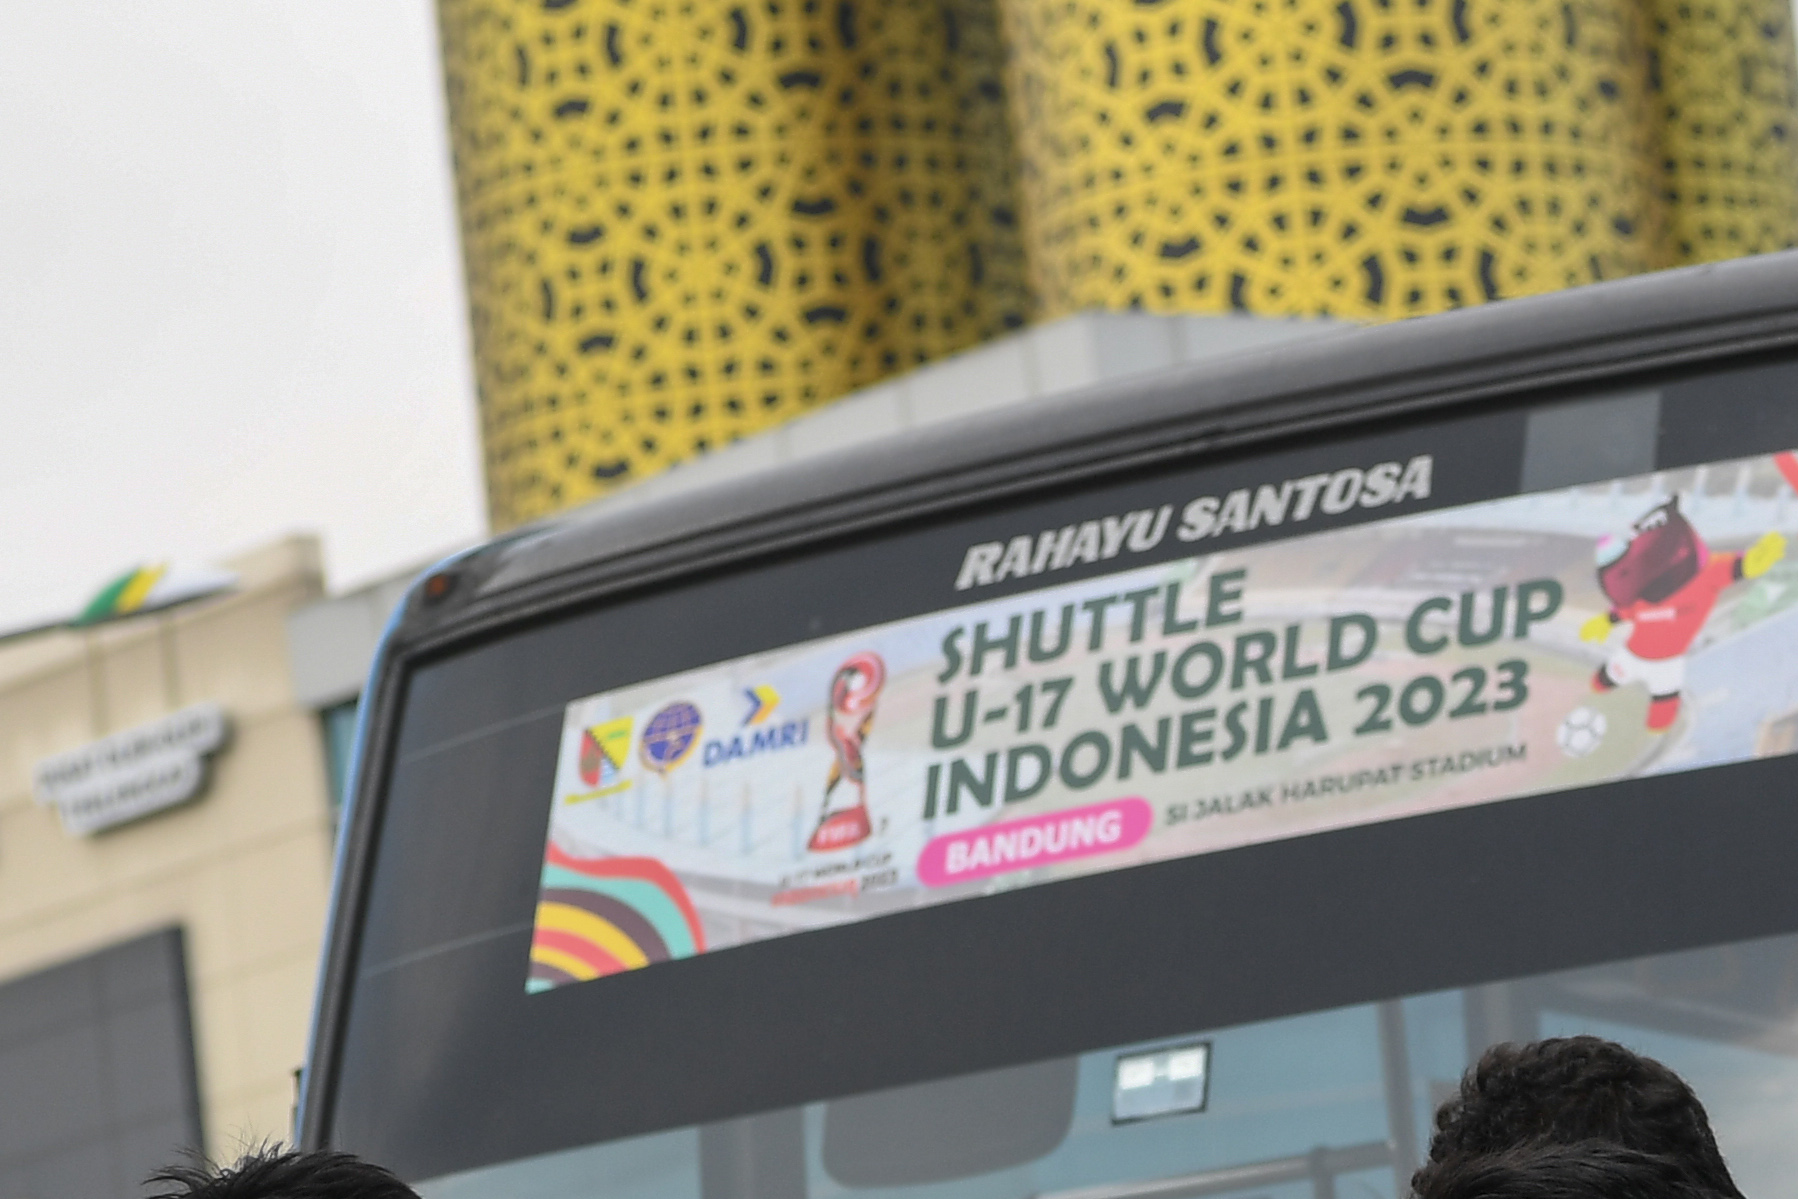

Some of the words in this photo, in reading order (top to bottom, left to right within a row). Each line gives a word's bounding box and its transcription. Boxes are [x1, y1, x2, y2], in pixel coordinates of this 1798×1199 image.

[954, 503, 1173, 591] RAHAYU
[1176, 453, 1433, 542] SANTOSA
[931, 677, 1074, 749] U-17
[1099, 613, 1379, 715] WORLD
[1405, 578, 1563, 655] CUP
[938, 569, 1246, 683] SHUTTLE
[703, 719, 809, 768] DAMRI
[923, 688, 1329, 819] INDONESIA
[1355, 660, 1529, 735] 2023
[1165, 805, 1188, 826] SI
[1194, 787, 1275, 821] JALAK
[1282, 764, 1408, 802] HARUPAT
[1410, 744, 1527, 781] STADIUM
[945, 809, 1123, 874] BANDUNG
